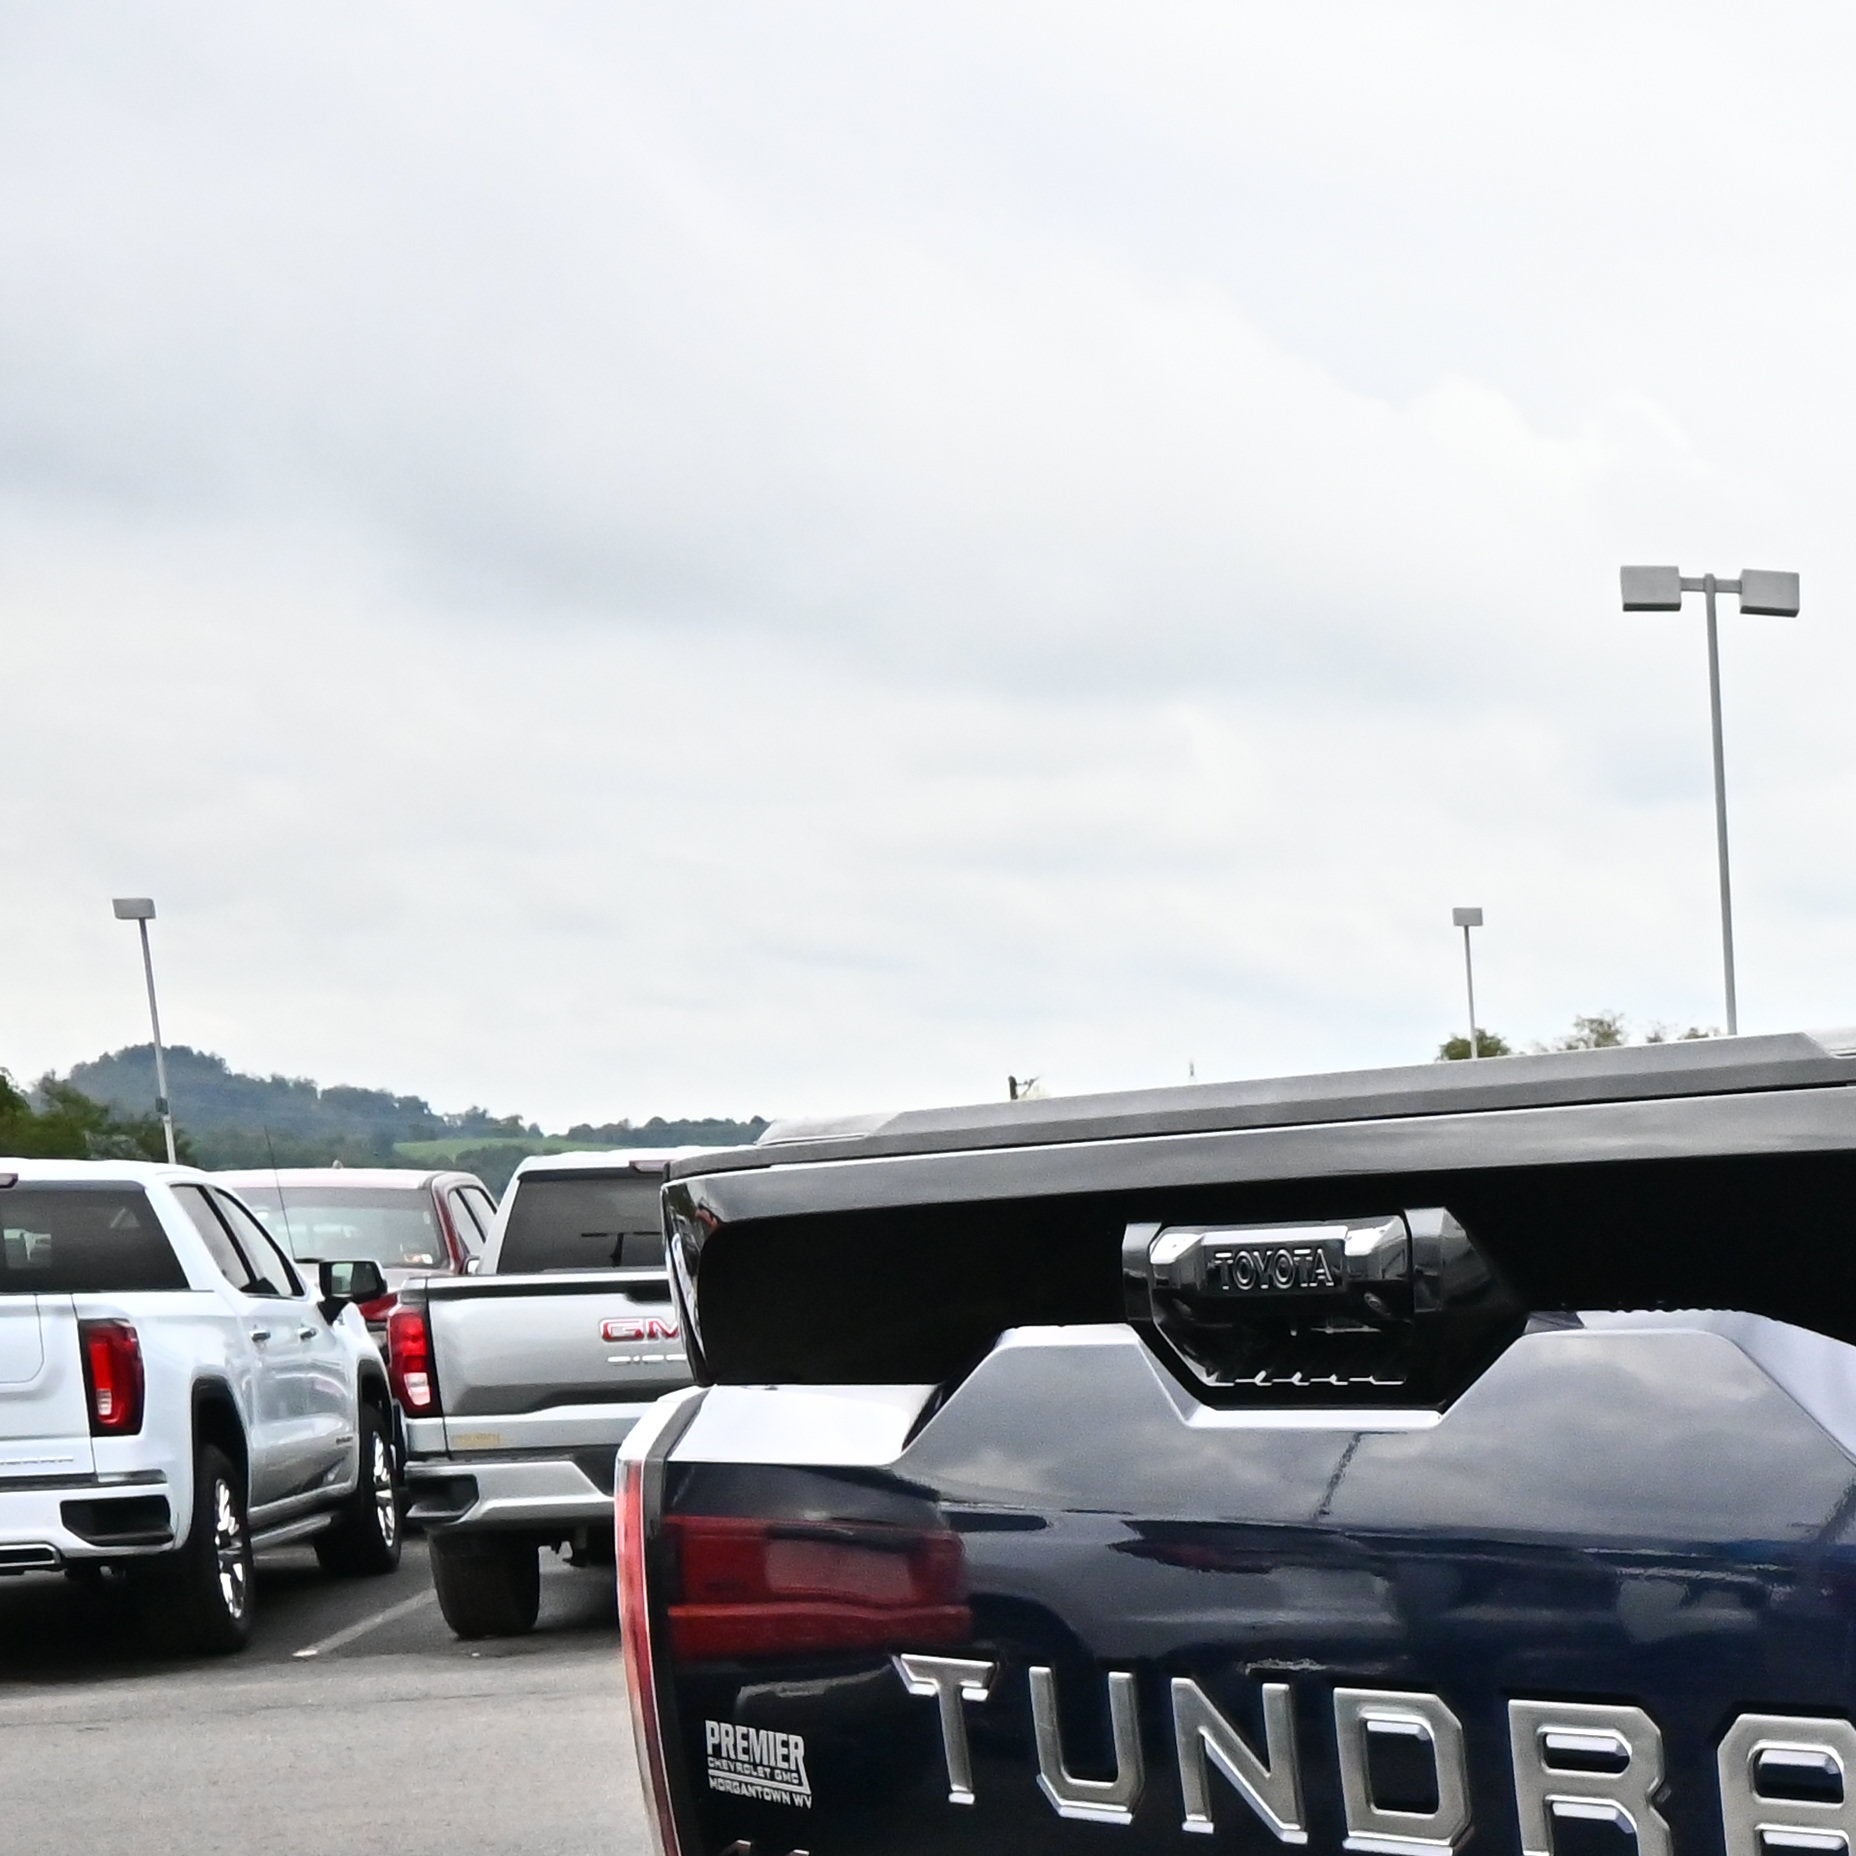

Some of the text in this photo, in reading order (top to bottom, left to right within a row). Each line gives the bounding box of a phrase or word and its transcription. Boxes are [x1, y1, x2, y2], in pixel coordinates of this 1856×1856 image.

[1214, 1249, 1334, 1290] TOYOTA
[600, 1316, 680, 1342] GM
[705, 1720, 805, 1772] PREMIER
[708, 1756, 799, 1784] CHEVROLET GMC
[709, 1776, 812, 1809] MORGANTOWN WV
